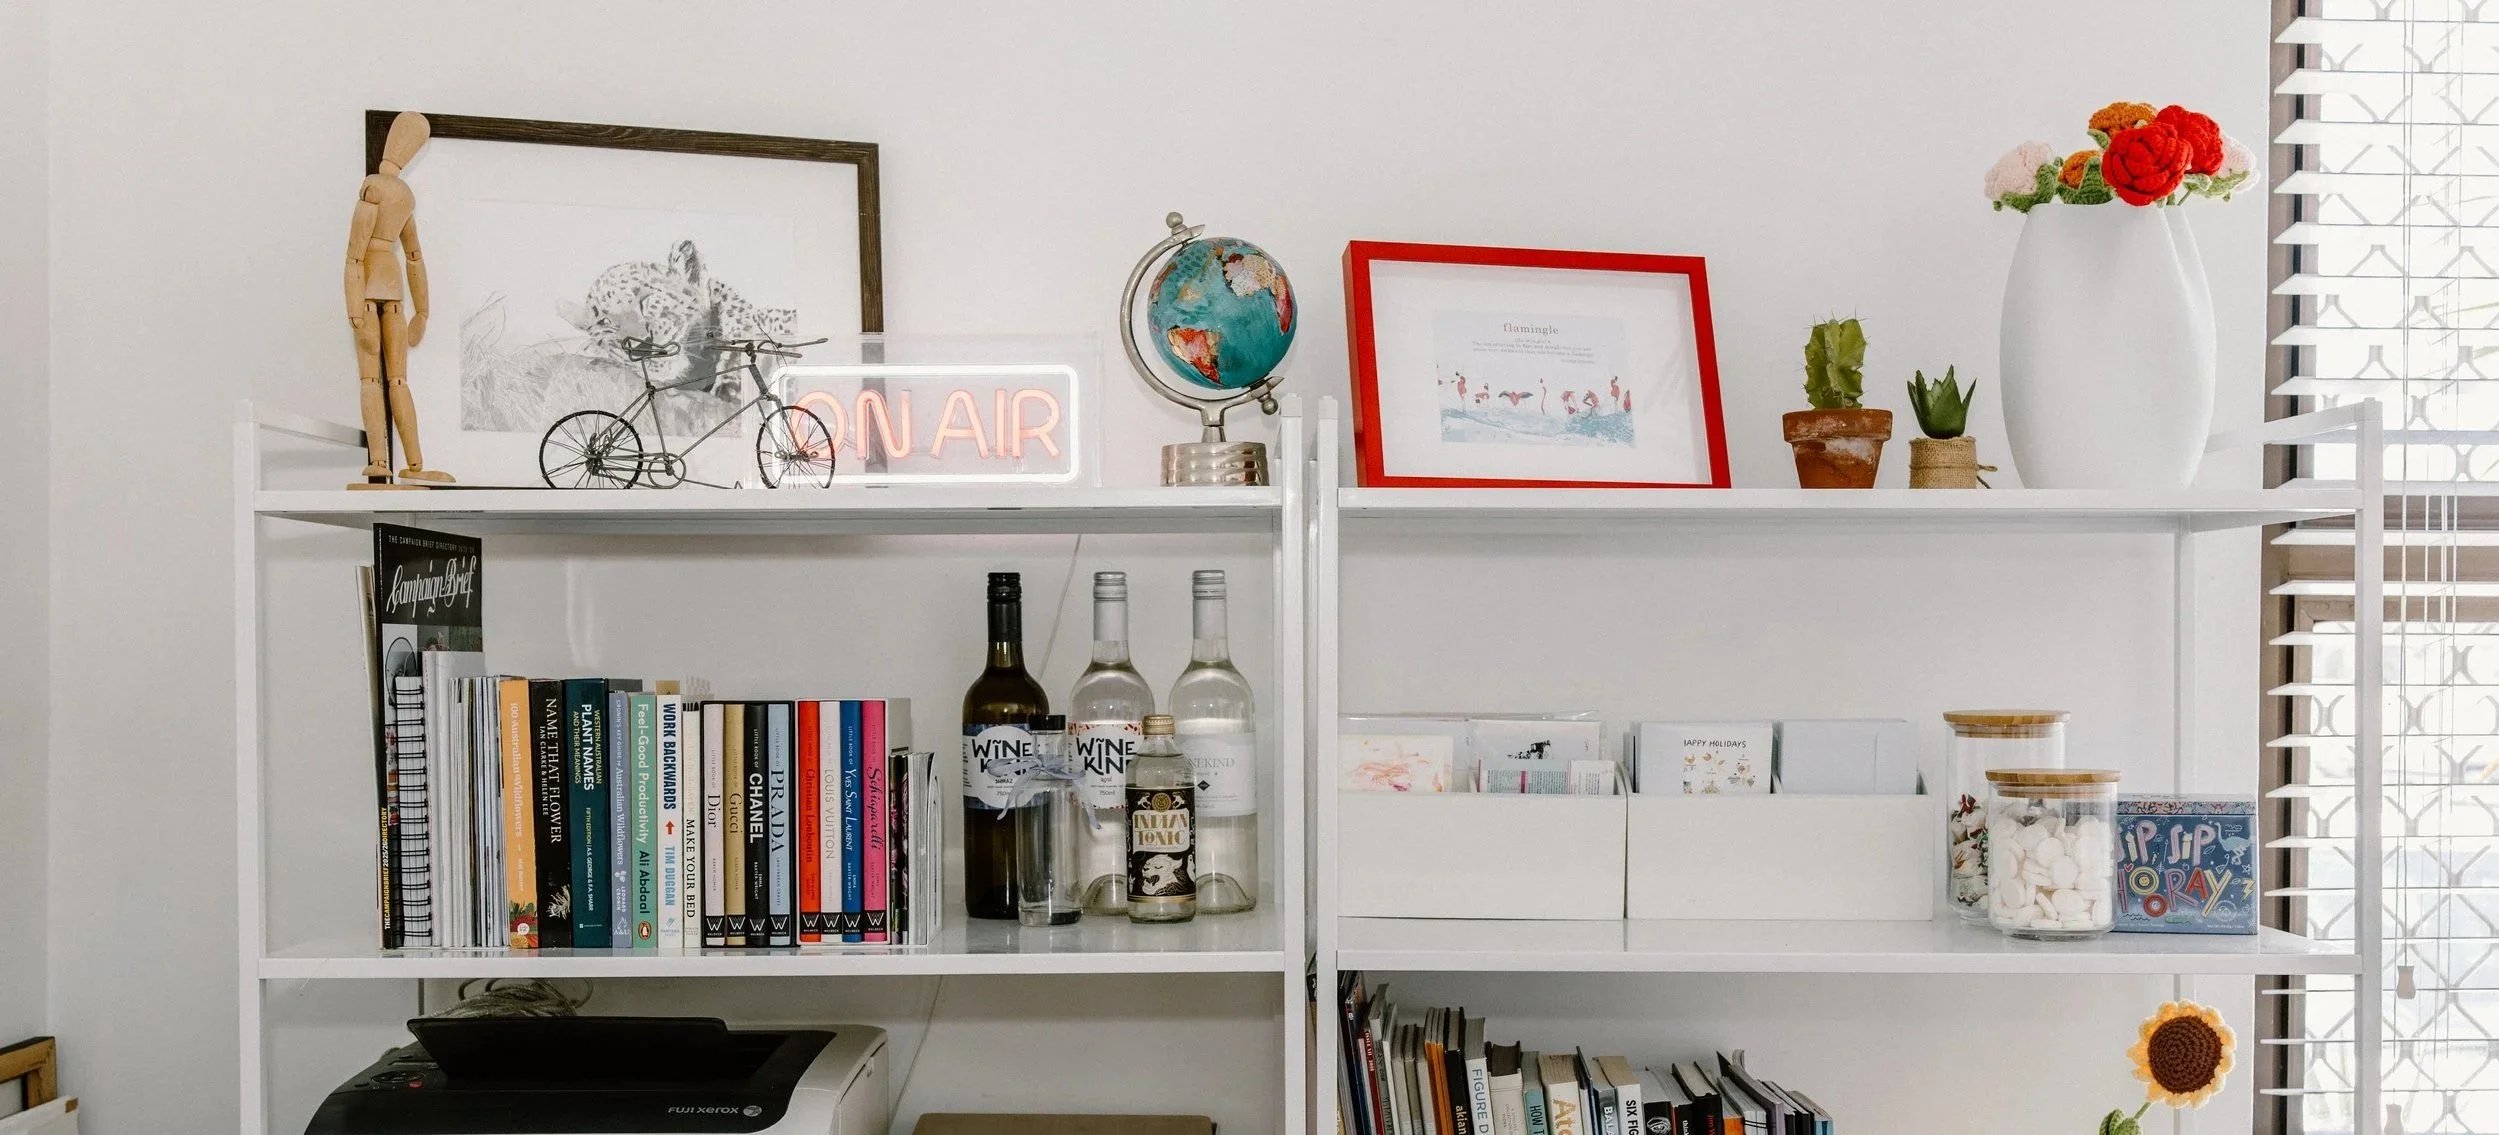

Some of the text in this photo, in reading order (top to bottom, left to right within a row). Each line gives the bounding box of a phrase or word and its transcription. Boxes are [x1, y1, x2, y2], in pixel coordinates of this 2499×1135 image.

[1503, 322, 1559, 336] flamingle
[790, 388, 1062, 460] ON AIR
[388, 534, 398, 544] THE
[400, 536, 422, 547] CAMPAIGN
[422, 539, 435, 548] BRIEF
[435, 541, 458, 552] DIRECTORY
[386, 560, 444, 618] Campaign
[442, 555, 477, 608] Brief
[511, 719, 522, 773] Australian
[572, 726, 581, 747] THEIR
[581, 703, 594, 790] PLANT NAMES
[593, 709, 602, 784] WESTERN AUSTRALIAN
[662, 703, 677, 810] WORK BACKWARDS
[1709, 740, 1747, 748] HOLIDAYS
[545, 698, 562, 844] NAME THAT FLOWER
[573, 747, 582, 784] MEANINGS
[636, 703, 650, 844] Feel-Good Productivity
[824, 769, 834, 803] LOUIS
[1084, 756, 1132, 776] KIN
[615, 767, 625, 812] Australian
[708, 794, 721, 828] Dior
[749, 772, 764, 844] CHANEL
[770, 770, 785, 854] PRADA
[805, 768, 815, 811] Christian
[866, 766, 884, 850] Schiaparelli
[685, 818, 696, 854] MAKE
[729, 793, 743, 834] Gucci
[824, 807, 835, 859] VUITTON
[1134, 814, 1188, 829] INDIAN
[616, 814, 626, 865] Wildflowers
[805, 814, 816, 863] Louboutin
[1135, 830, 1185, 846] TONIC
[639, 850, 650, 914] Ali Abdaal
[664, 845, 676, 906] TIM DUGGAN
[686, 856, 696, 890] YOUR
[686, 894, 696, 918] BED
[1472, 1068, 1488, 1120] FIGURE
[1529, 1105, 1543, 1126] HOW
[1626, 1099, 1638, 1117] SIX
